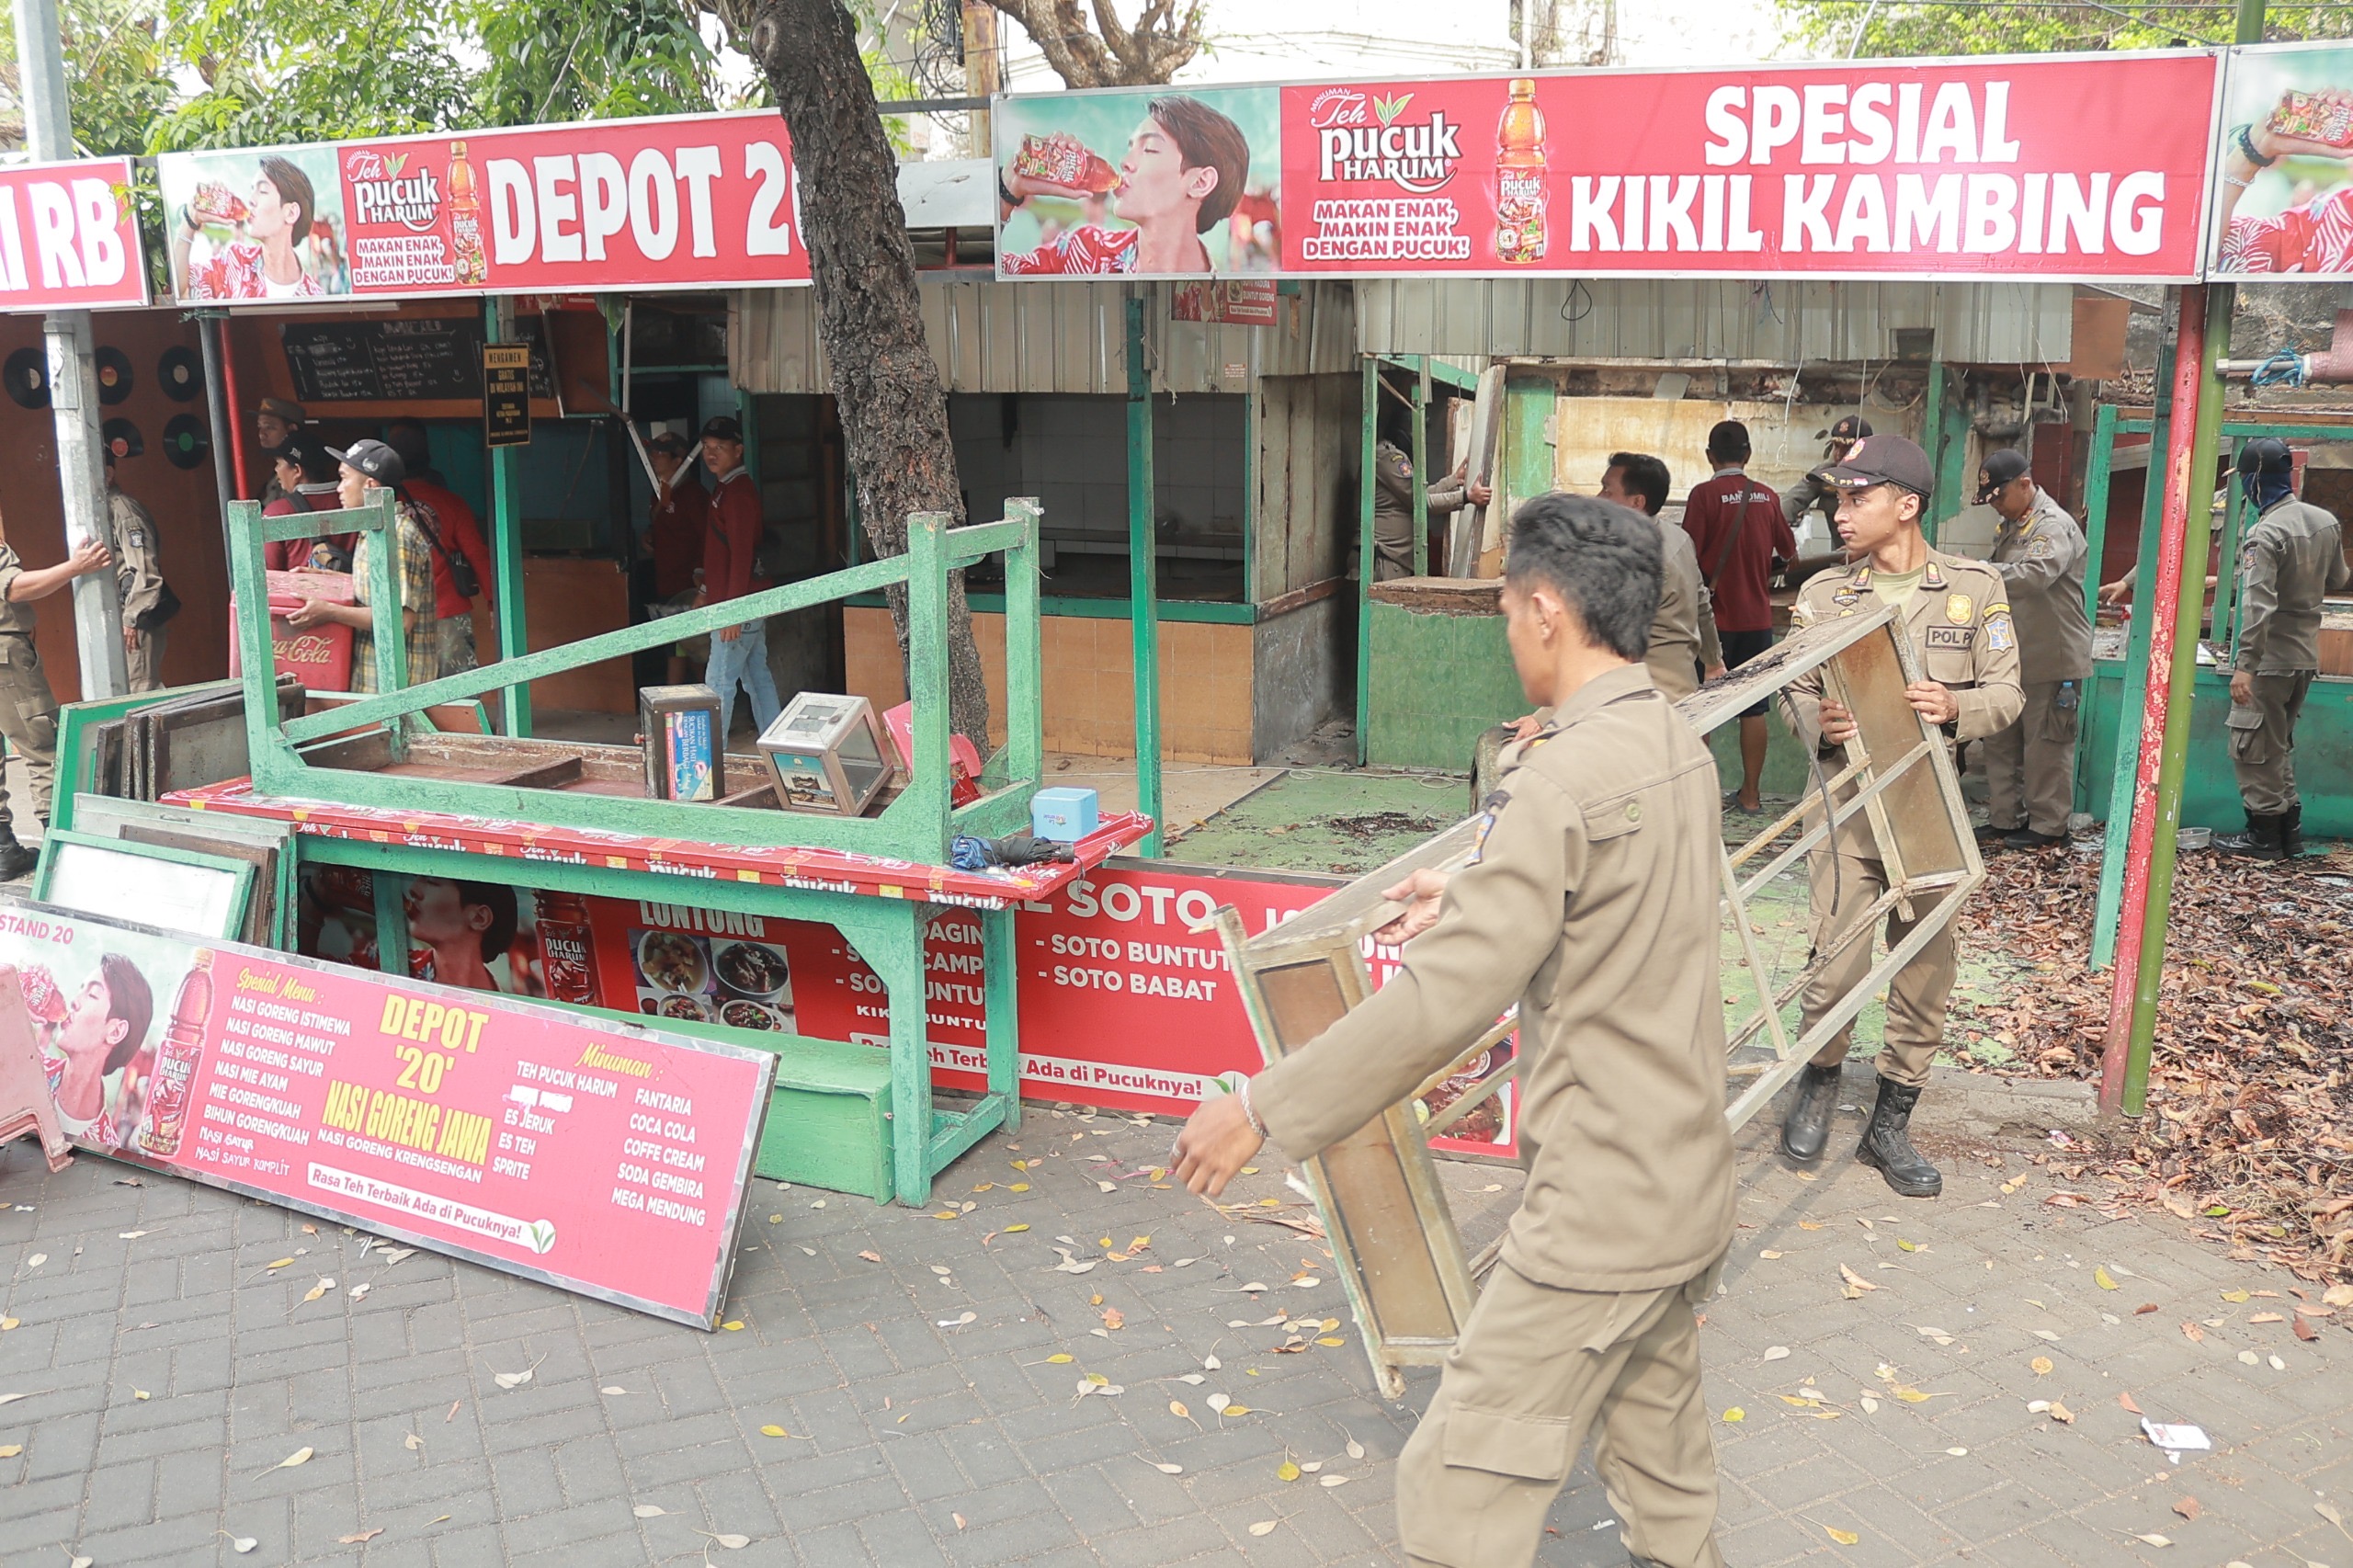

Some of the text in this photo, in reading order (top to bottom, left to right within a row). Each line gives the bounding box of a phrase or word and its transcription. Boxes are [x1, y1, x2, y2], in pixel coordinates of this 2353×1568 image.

[1310, 87, 1352, 113] MINUMAN
[1311, 93, 1368, 128] Teh
[1704, 80, 2020, 166] SPESIAL
[1319, 110, 1461, 182] pucuk
[347, 153, 381, 182] Teh
[1344, 158, 1452, 188] HARUM
[353, 167, 441, 225] pucuk
[486, 140, 807, 266] DEPOT 2
[1501, 176, 1541, 197] pucuk
[371, 204, 438, 229] HARUM
[1316, 201, 1458, 222] MAKAN ENAK,
[1570, 170, 2165, 256] KIKIL KAMBING
[28, 177, 126, 290] RB
[358, 237, 445, 254] MAKAN ENAK,
[1305, 239, 1469, 256] DENGAN PUCUK!
[1323, 222, 1449, 238] MAKIN ENAK
[355, 267, 454, 284] DENGAN PUCUK!
[363, 254, 440, 268] MAKIN ENAK
[489, 352, 521, 363] MENGAMEN
[1822, 472, 1836, 483] POL
[1932, 630, 1960, 643] POL
[1066, 879, 1218, 929] SOTO
[0, 914, 74, 945] STAND 20
[1051, 934, 1121, 960] SOTO
[1127, 941, 1232, 972] BUNTUT
[236, 968, 279, 995] Spesial
[279, 978, 317, 1004] Menu
[1053, 965, 1123, 992] SOTO
[1130, 972, 1218, 1002] BABAT
[232, 995, 351, 1037] NASI GORENG ISTIMEWA
[379, 993, 490, 1054] DEPOT
[225, 1017, 336, 1057] NASI GORENG MAWUT
[214, 1060, 289, 1093] NASI MIE AYAM
[220, 1039, 324, 1078] NASI GORENG SAYUR
[574, 1041, 654, 1080] Minuman
[517, 1060, 538, 1081] TEH
[538, 1064, 577, 1090] PUCUK
[576, 1074, 619, 1099] HARUM
[1026, 1059, 1065, 1079] Ada
[1070, 1065, 1088, 1082] di
[1094, 1067, 1203, 1096] Pucuknya!
[209, 1082, 302, 1120] MIE GORENG/KUAH
[634, 1088, 692, 1117] FANTARIA
[199, 1125, 223, 1145] NASI
[203, 1104, 311, 1146] BIHUN GORENG/KUAH
[322, 1079, 369, 1131] NASI
[364, 1089, 441, 1153] GORENG
[436, 1108, 494, 1166] JAWA
[504, 1108, 556, 1136] ES JERUK
[630, 1112, 696, 1144] COCA COLA
[221, 1152, 251, 1168] SAYUR
[317, 1128, 483, 1185] NASI GORENG KRENGSENGAN
[497, 1131, 537, 1156] ES TEH
[623, 1137, 706, 1174] COFFE CREAM
[492, 1155, 531, 1181] SPRITE
[617, 1162, 704, 1200] SODA GEMBIRA
[312, 1168, 522, 1241] Rasa Teh Terbaik Ada di Pucuknya!
[610, 1187, 707, 1228] MEGA MENDUNG
